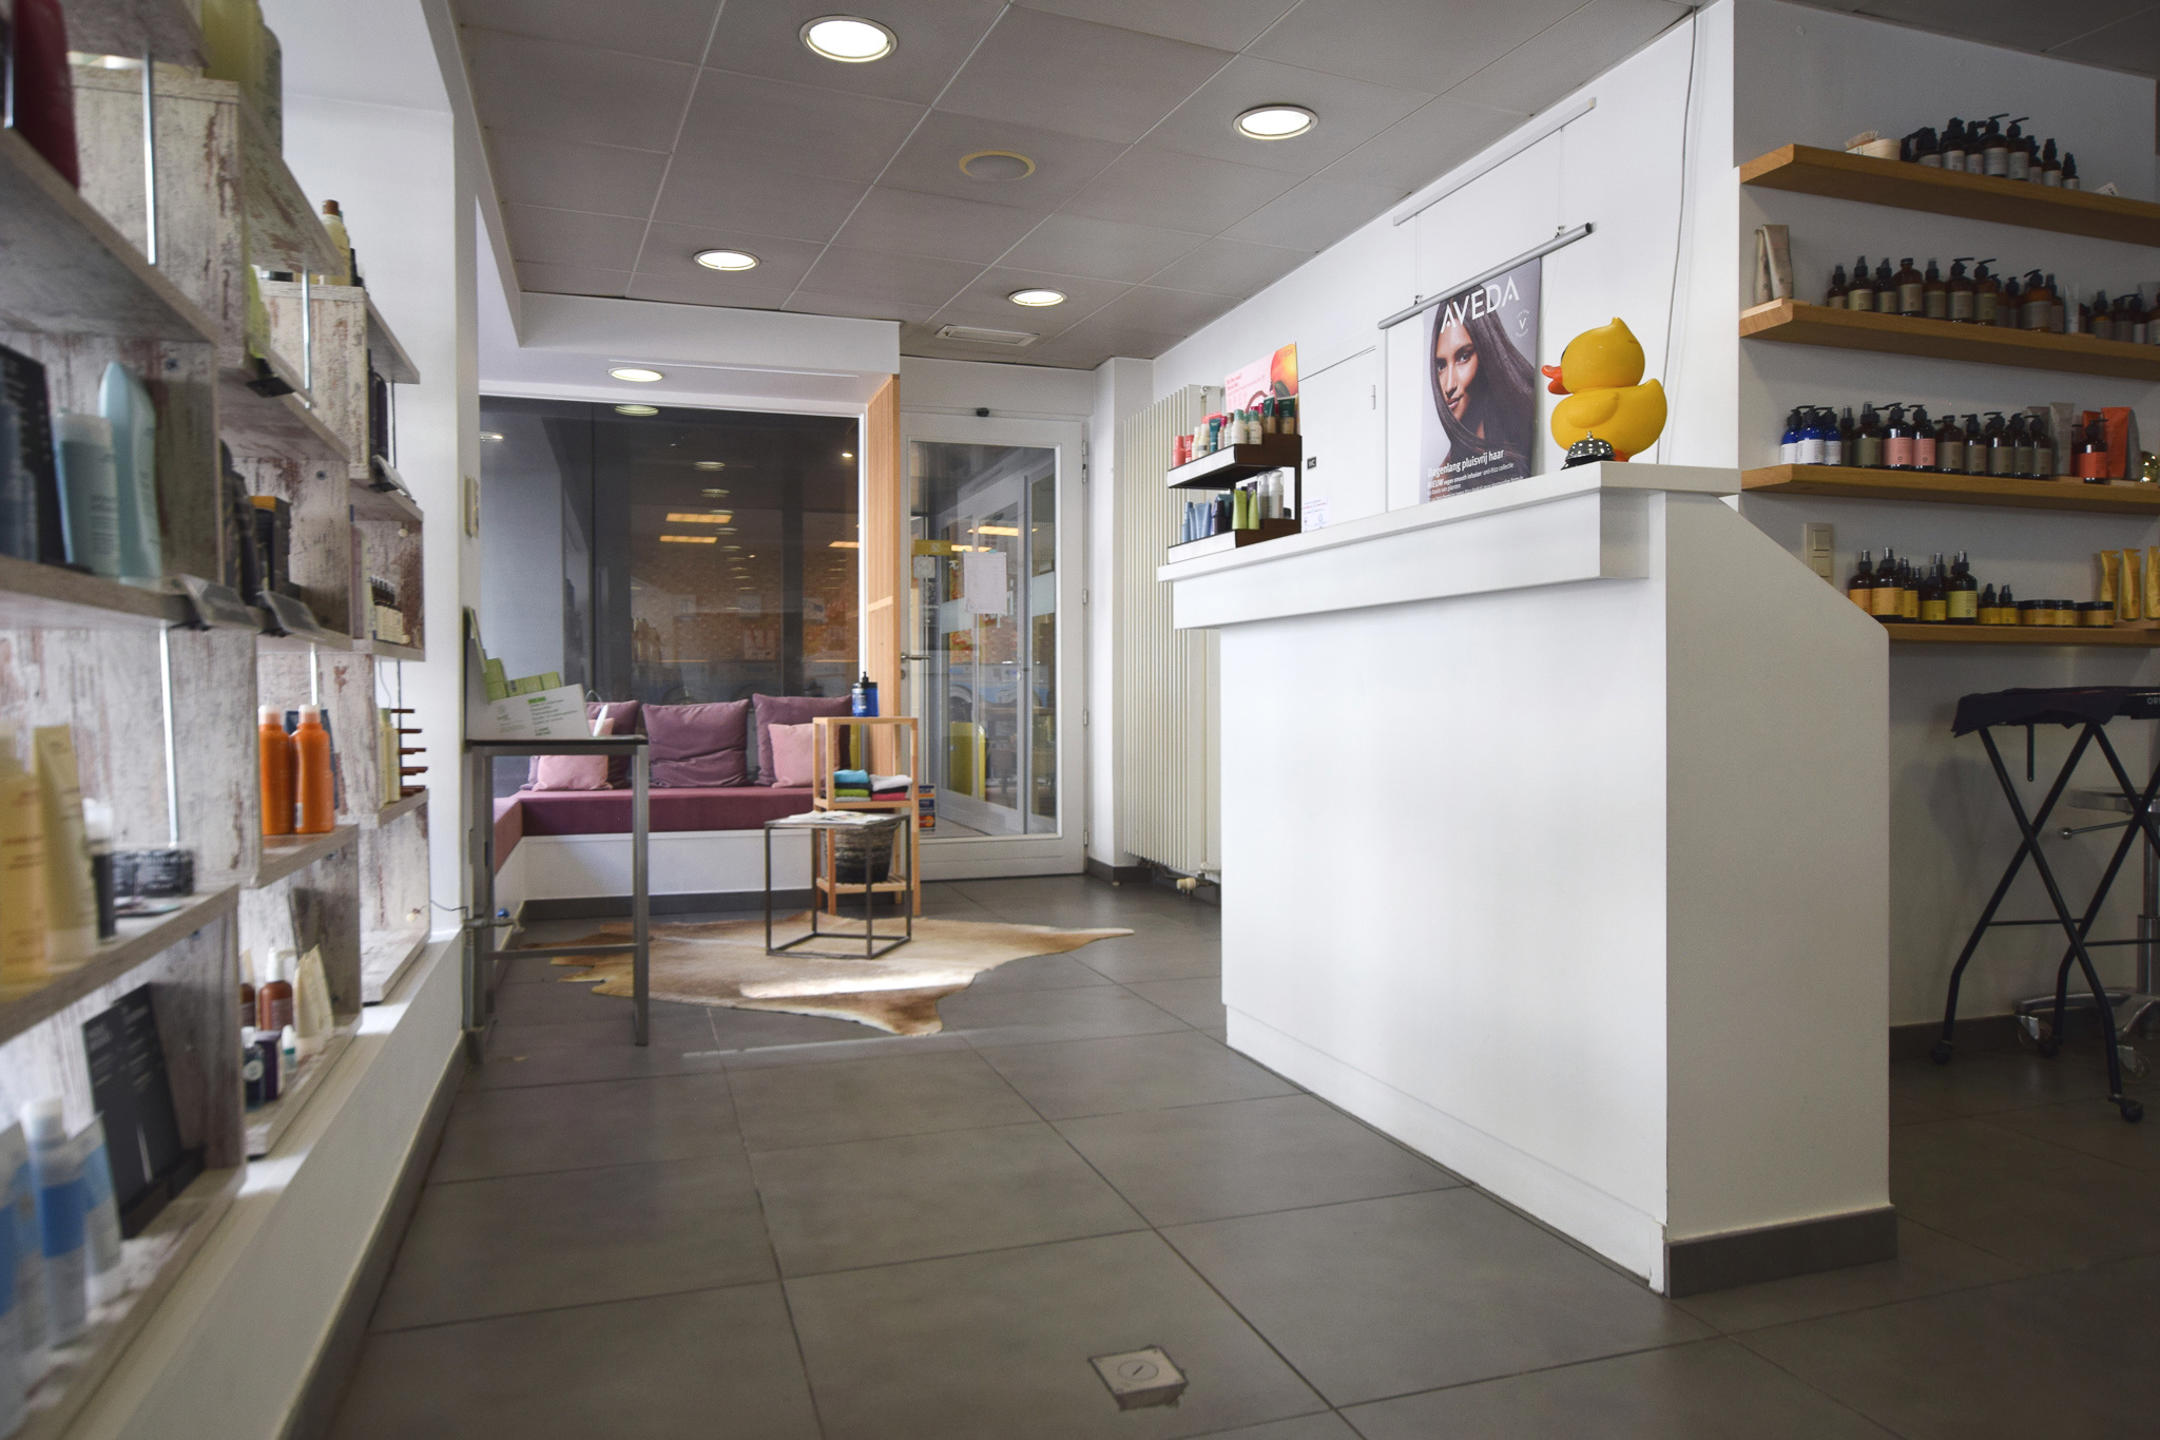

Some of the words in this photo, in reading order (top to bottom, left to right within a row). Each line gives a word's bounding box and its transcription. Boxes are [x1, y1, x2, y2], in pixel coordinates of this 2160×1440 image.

[1440, 276, 1520, 334] AVEDA
[1462, 451, 1488, 471] pluisvrij
[1489, 449, 1504, 462] haar
